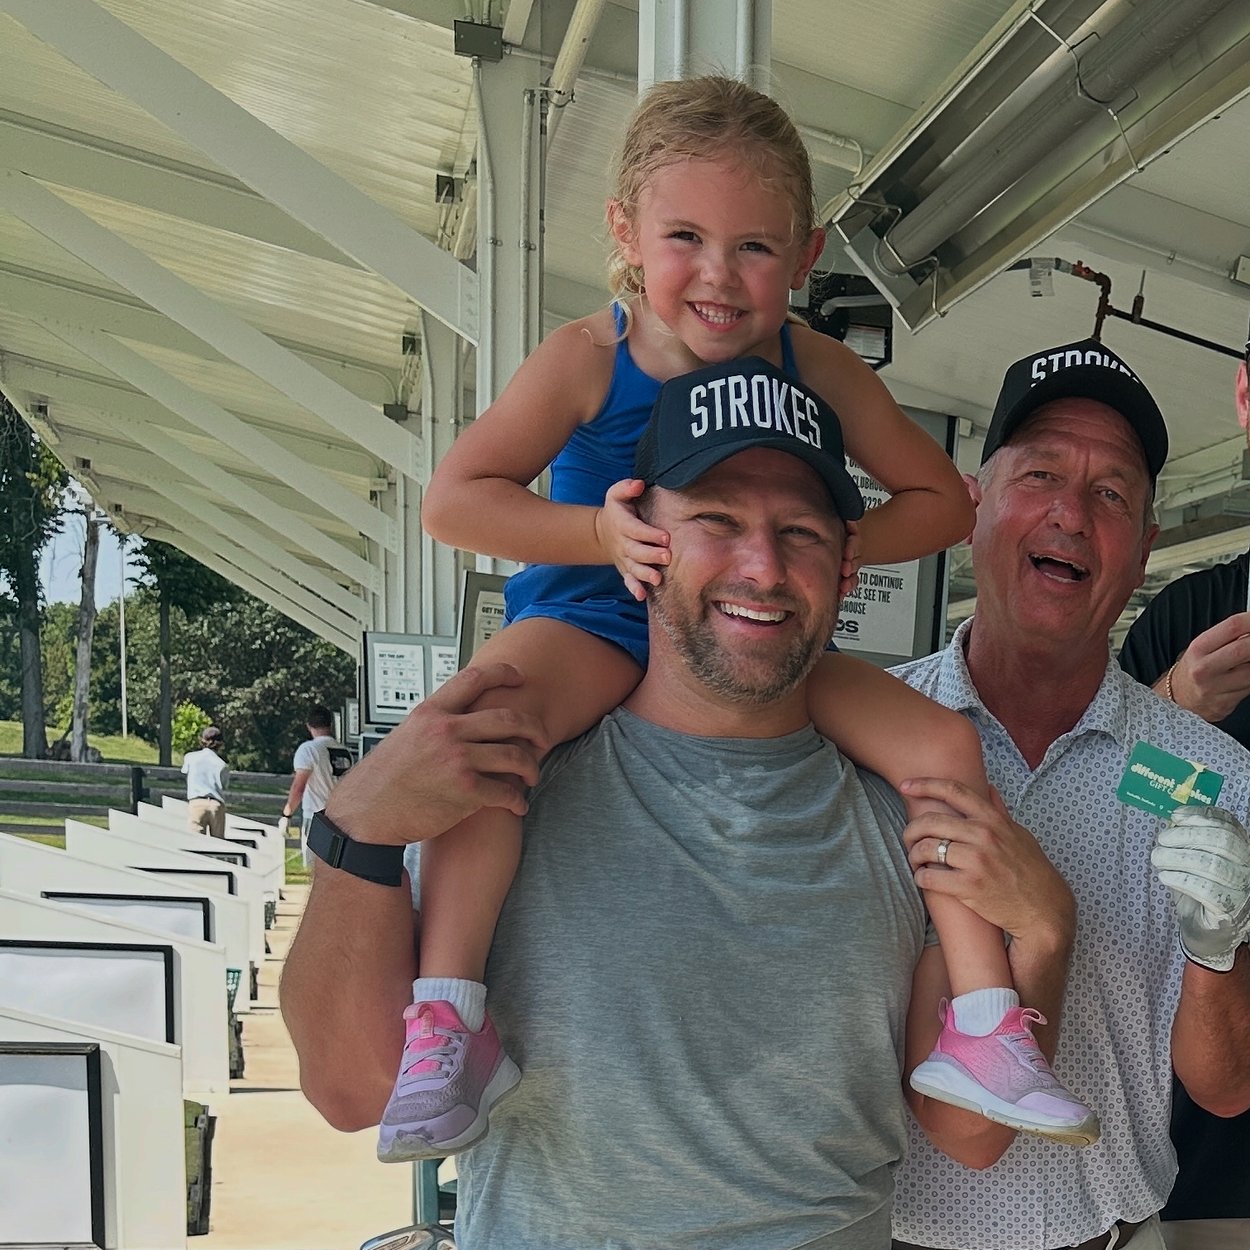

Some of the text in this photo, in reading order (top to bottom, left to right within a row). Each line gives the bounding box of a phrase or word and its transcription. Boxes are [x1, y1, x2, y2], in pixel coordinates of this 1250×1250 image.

[690, 374, 822, 450] STROKES
[859, 572, 904, 590] TO CONTINUE
[864, 588, 876, 601] SEE
[878, 590, 891, 603] THE
[840, 600, 867, 615] BHOUSE
[1131, 763, 1175, 788] different
[1149, 781, 1168, 792] GIFT
